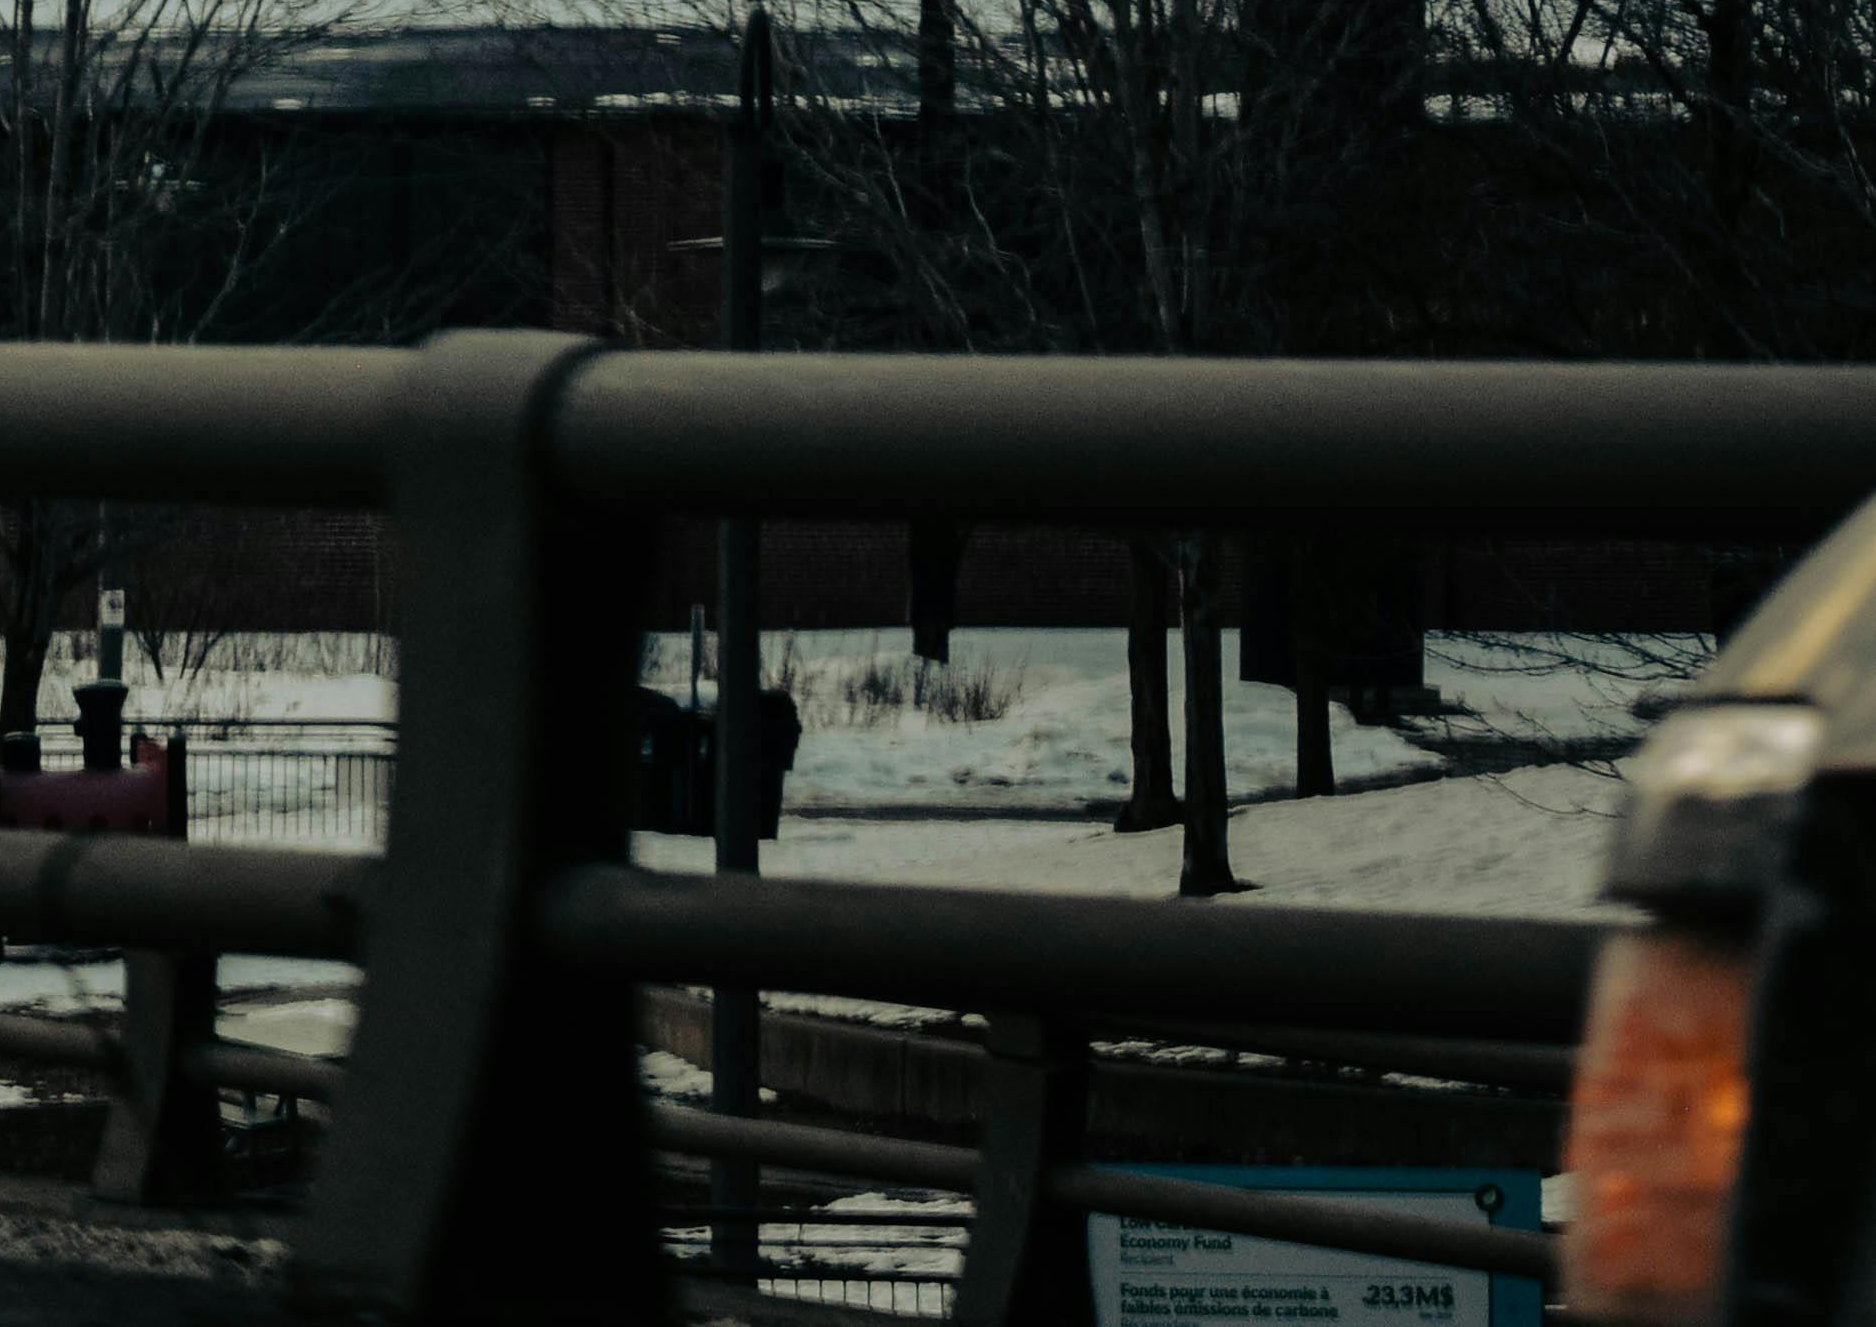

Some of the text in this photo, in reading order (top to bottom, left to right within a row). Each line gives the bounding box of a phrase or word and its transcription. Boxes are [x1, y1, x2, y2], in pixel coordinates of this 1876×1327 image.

[1120, 1234, 1232, 1251] Economy Fund
[1120, 1282, 1167, 1297] Fonds
[1170, 1286, 1205, 1302] pour
[1209, 1287, 1238, 1299] une
[1120, 1299, 1339, 1318] faibles émissions de carbone
